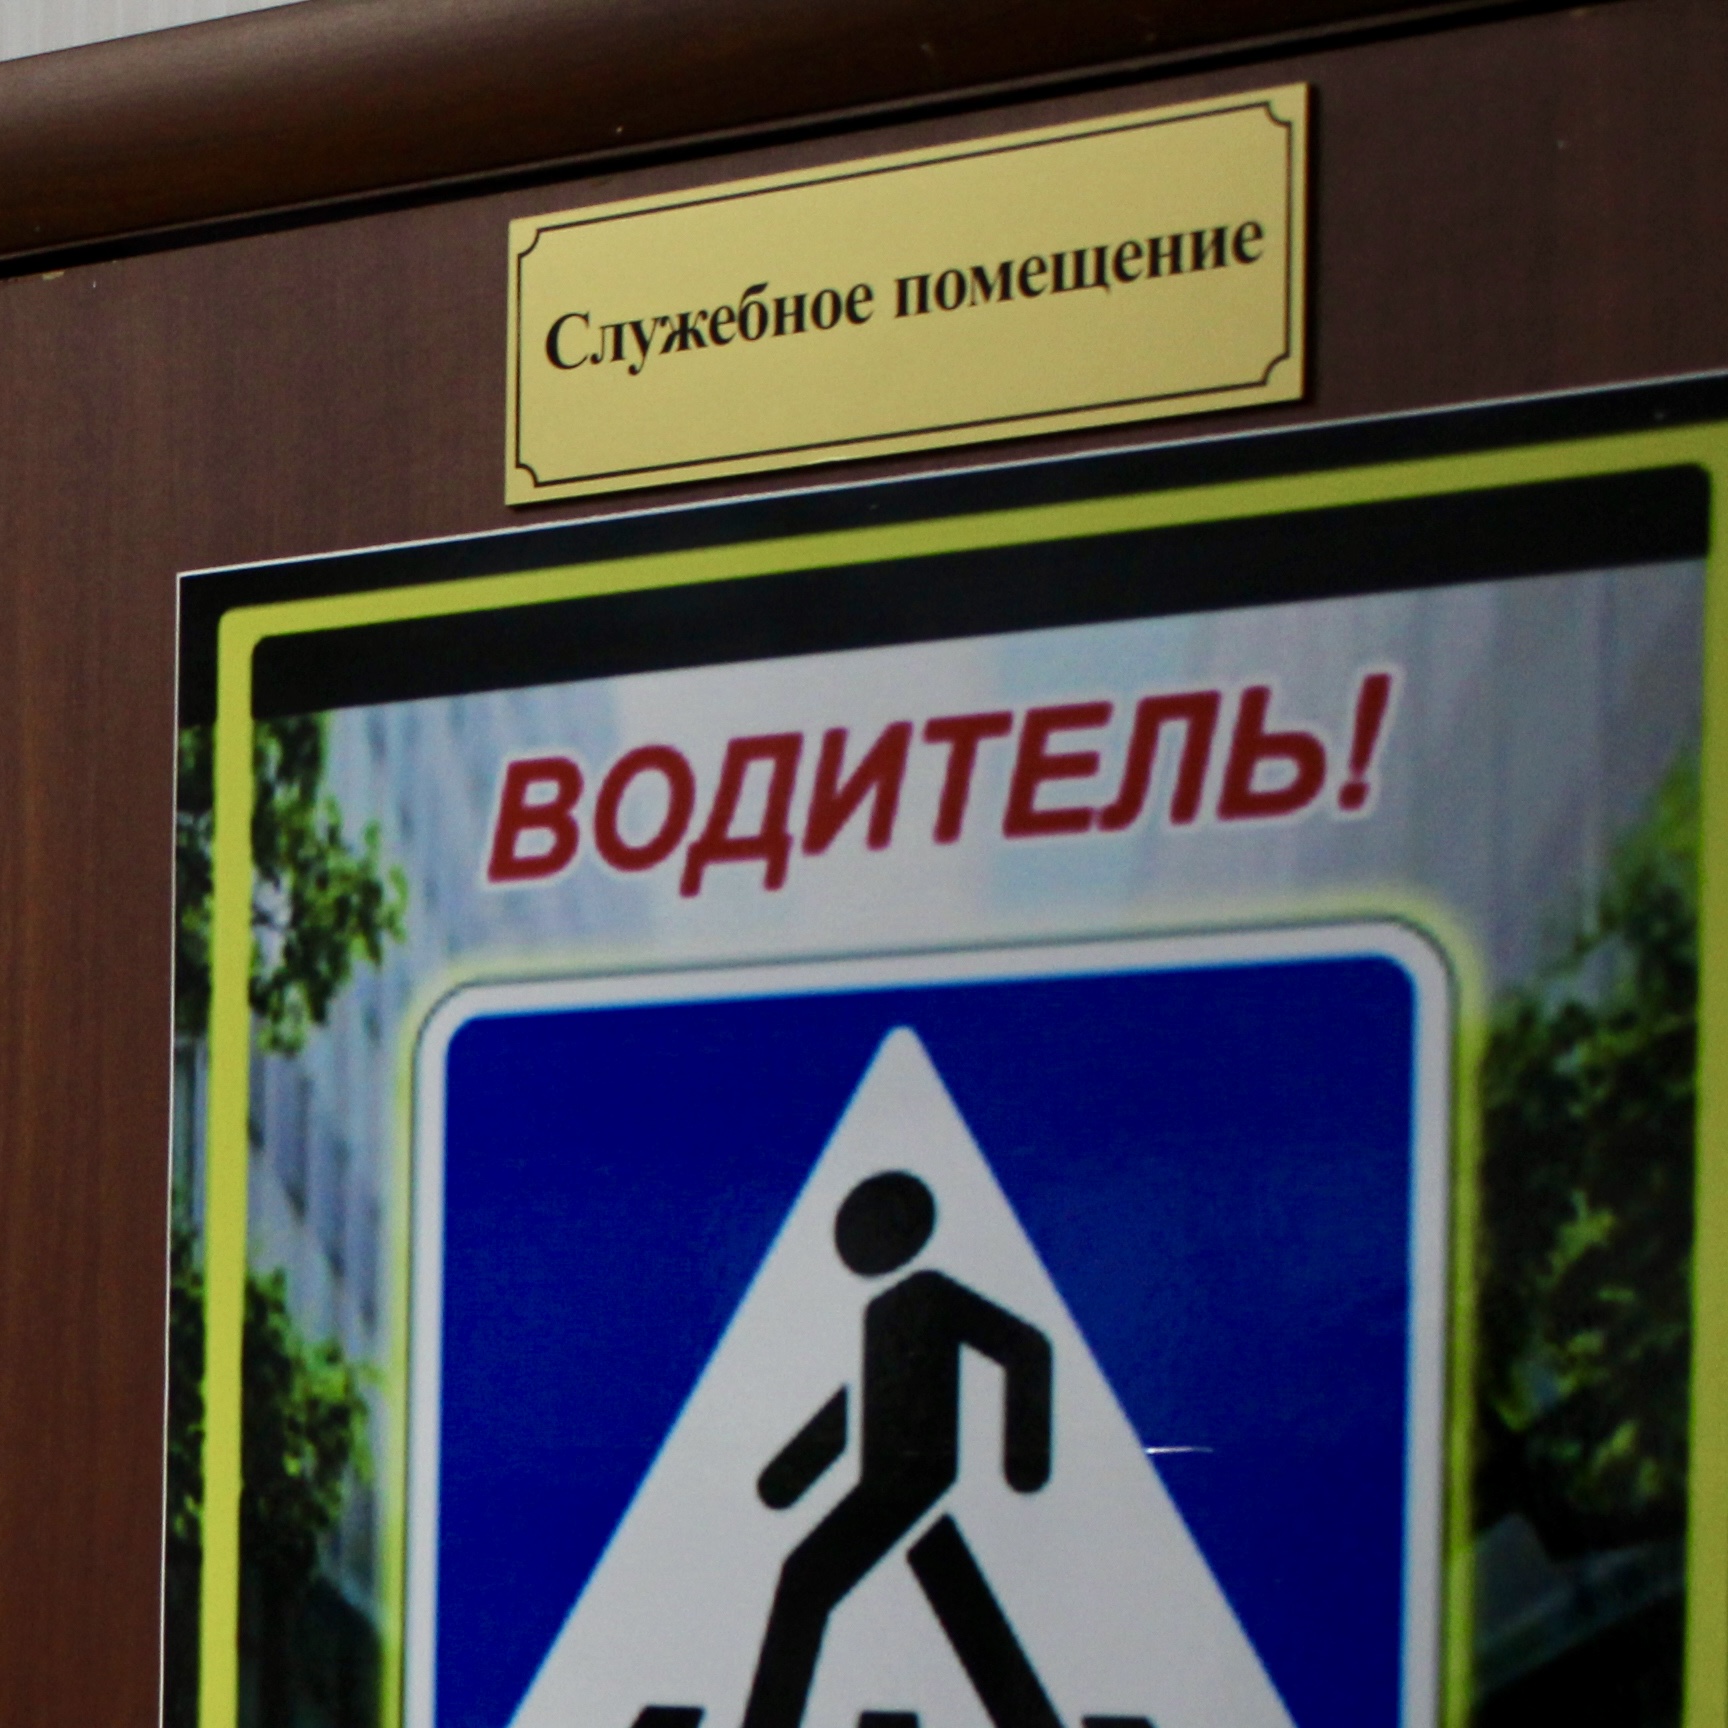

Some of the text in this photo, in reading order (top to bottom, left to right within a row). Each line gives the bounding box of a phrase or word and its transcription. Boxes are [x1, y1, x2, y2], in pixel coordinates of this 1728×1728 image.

[545, 220, 1265, 375] Служебное помещение
[487, 673, 1391, 898] ВОДИТЕЛЬ!
